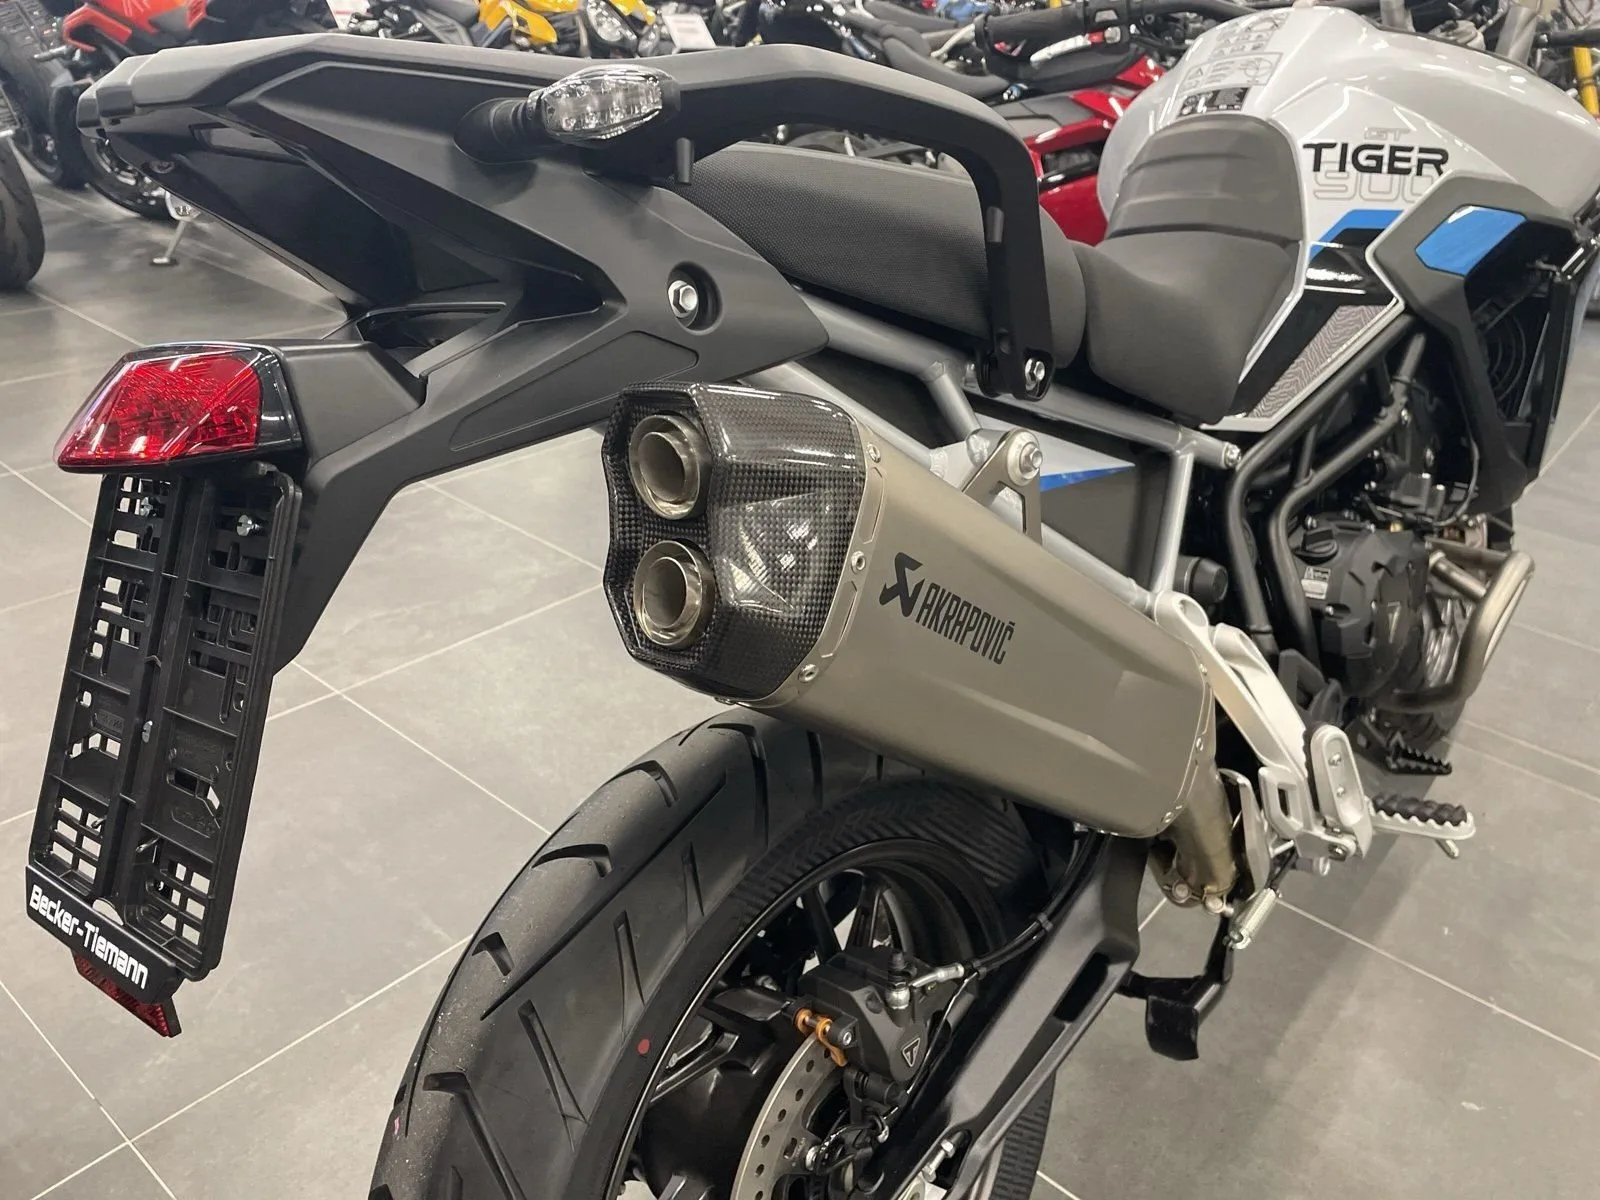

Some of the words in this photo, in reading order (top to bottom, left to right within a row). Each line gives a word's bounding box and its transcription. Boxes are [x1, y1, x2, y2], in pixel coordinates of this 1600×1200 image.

[1302, 142, 1449, 177] TIGER
[915, 582, 1016, 665] AKRAPOVIČ
[29, 884, 149, 990] Becker-Tiemann
